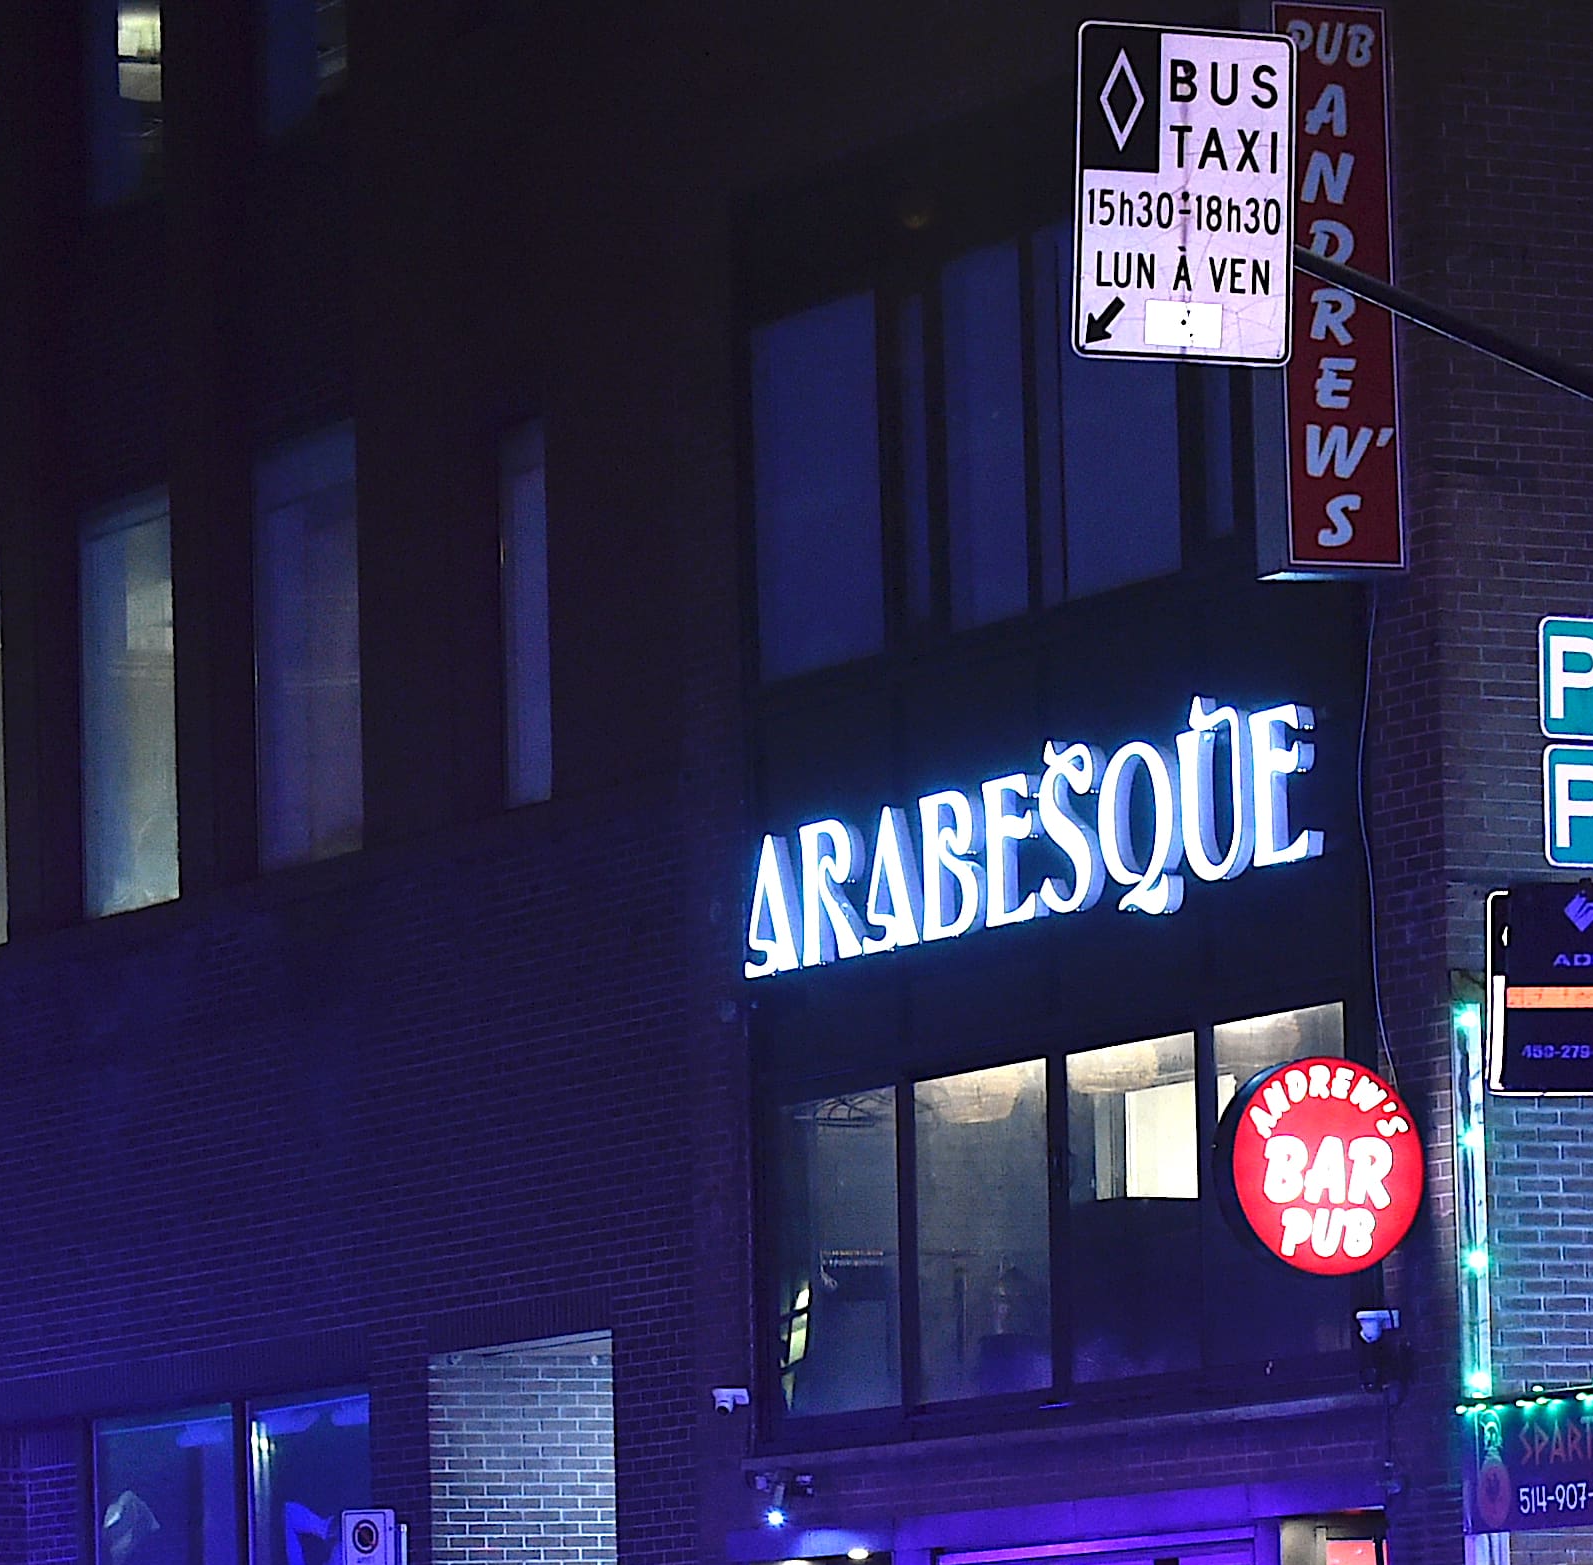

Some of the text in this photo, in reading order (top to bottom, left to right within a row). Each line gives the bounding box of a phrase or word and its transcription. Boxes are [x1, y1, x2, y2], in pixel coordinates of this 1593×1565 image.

[1286, 19, 1375, 68] PUB
[1169, 58, 1279, 110] BUS
[1169, 124, 1278, 174] TAXI
[1087, 187, 1282, 236] 15h30-18h30
[1095, 245, 1270, 296] LUN À VEN
[743, 694, 1325, 979] ARABESQUE
[1248, 1064, 1410, 1140] ANDREW'S
[1262, 1133, 1394, 1210] BAR
[1280, 1206, 1377, 1258] PUB
